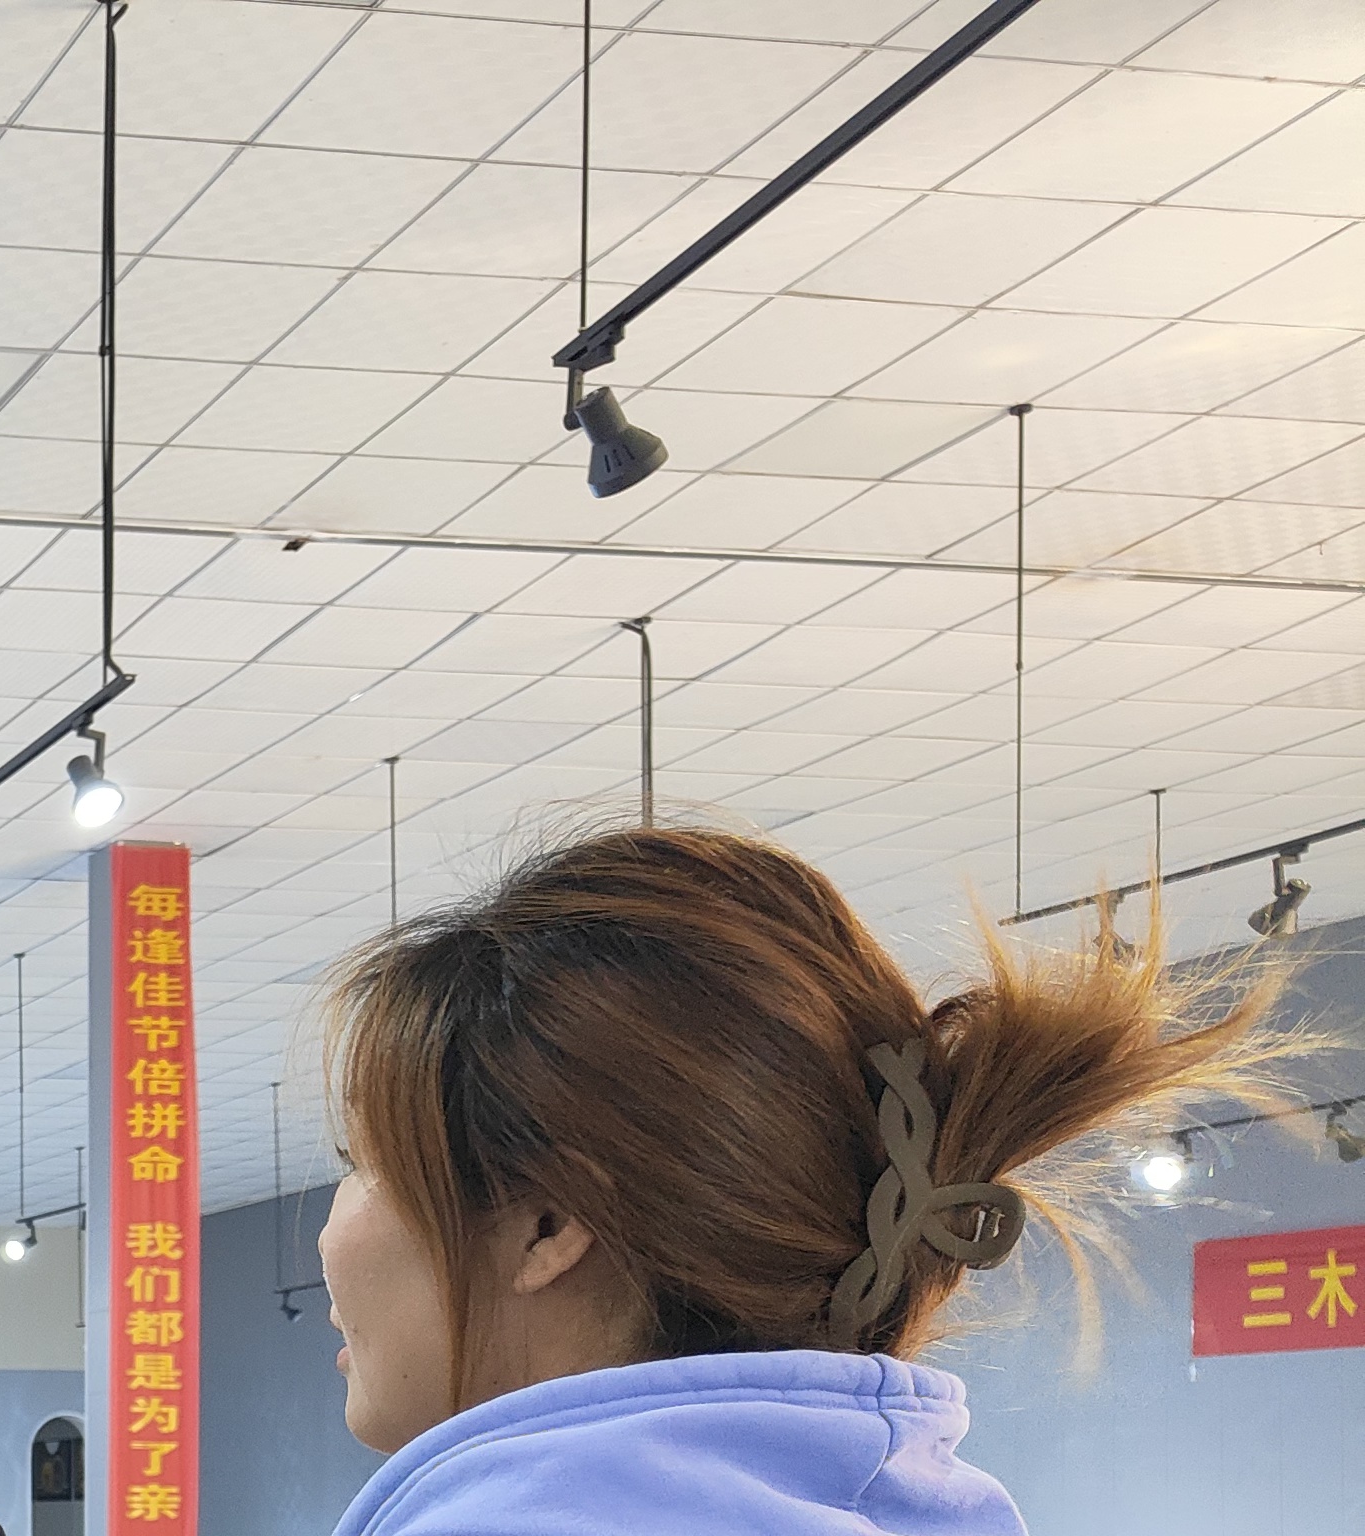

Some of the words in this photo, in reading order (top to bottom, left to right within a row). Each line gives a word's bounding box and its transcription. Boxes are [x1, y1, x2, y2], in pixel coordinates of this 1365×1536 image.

[127, 884, 187, 1184] 每逢佳节倍拼命
[124, 1221, 185, 1522] 我们都是为了亲
[1242, 1249, 1358, 1328] 三木
